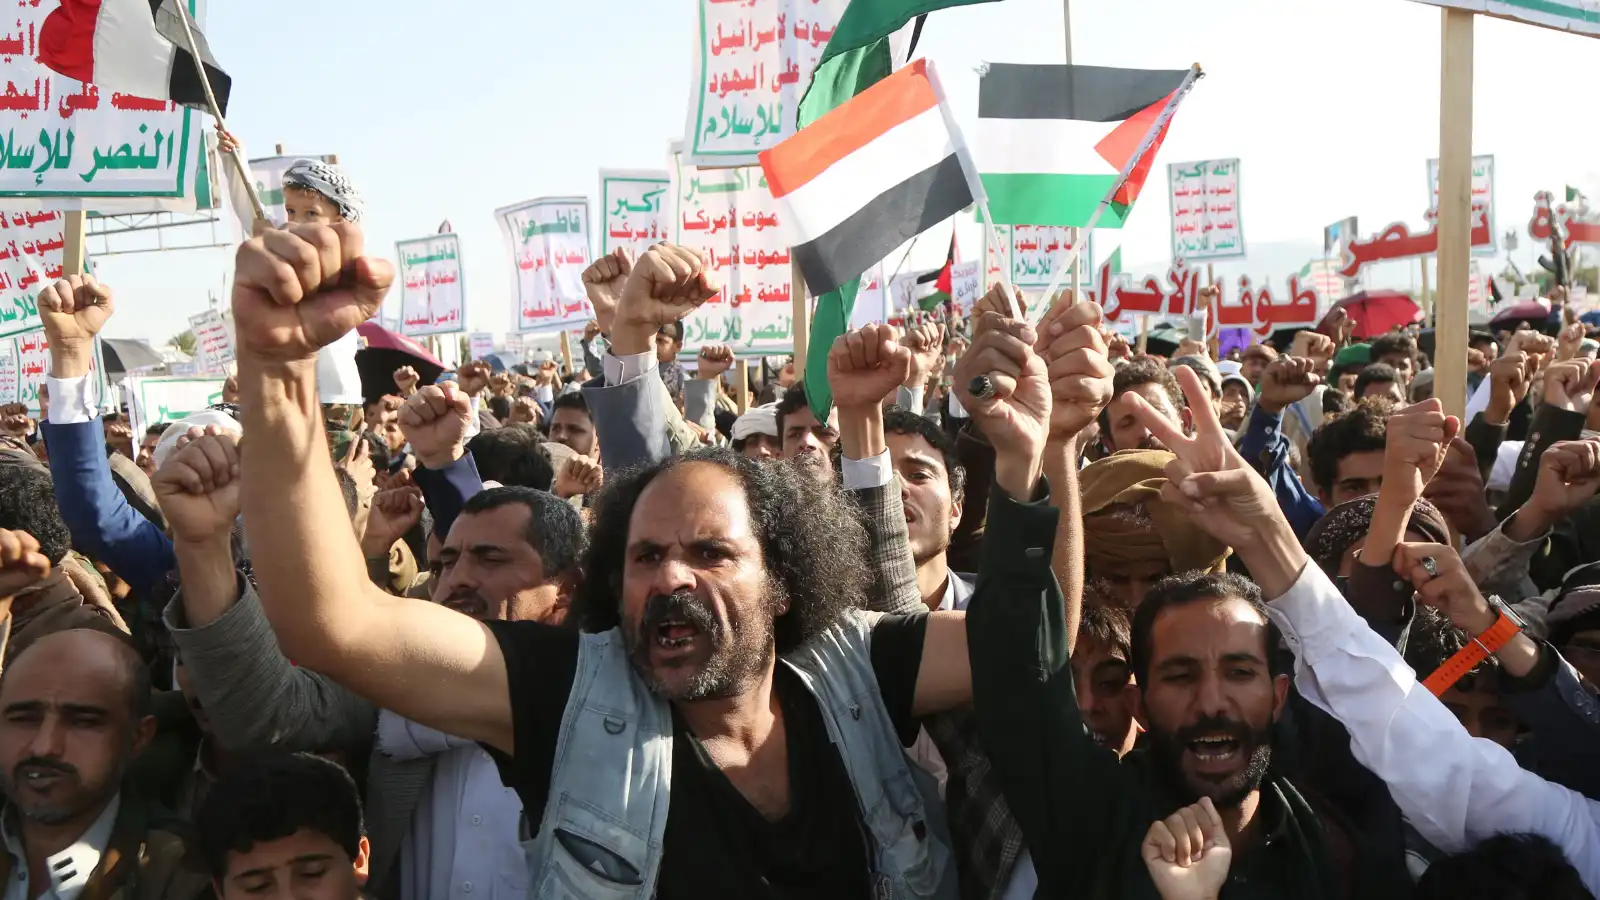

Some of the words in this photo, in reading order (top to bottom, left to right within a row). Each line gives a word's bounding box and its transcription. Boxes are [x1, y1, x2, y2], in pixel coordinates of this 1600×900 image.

[711, 12, 787, 56] لإسرائيل
[709, 61, 764, 98] اليهود
[771, 56, 800, 92] على
[0, 76, 50, 119] اليه
[703, 102, 784, 146] للإسلام
[79, 123, 174, 182] النصر
[610, 184, 667, 219] أكبر
[683, 203, 737, 234] لأمريكا
[742, 210, 779, 232] موت
[23, 232, 65, 257] لموت
[743, 246, 791, 270] لموت
[17, 267, 39, 290] على
[758, 281, 791, 303] للعنة
[731, 284, 753, 308] على
[1206, 275, 1317, 337] طوفا
[744, 314, 794, 348] النصر
